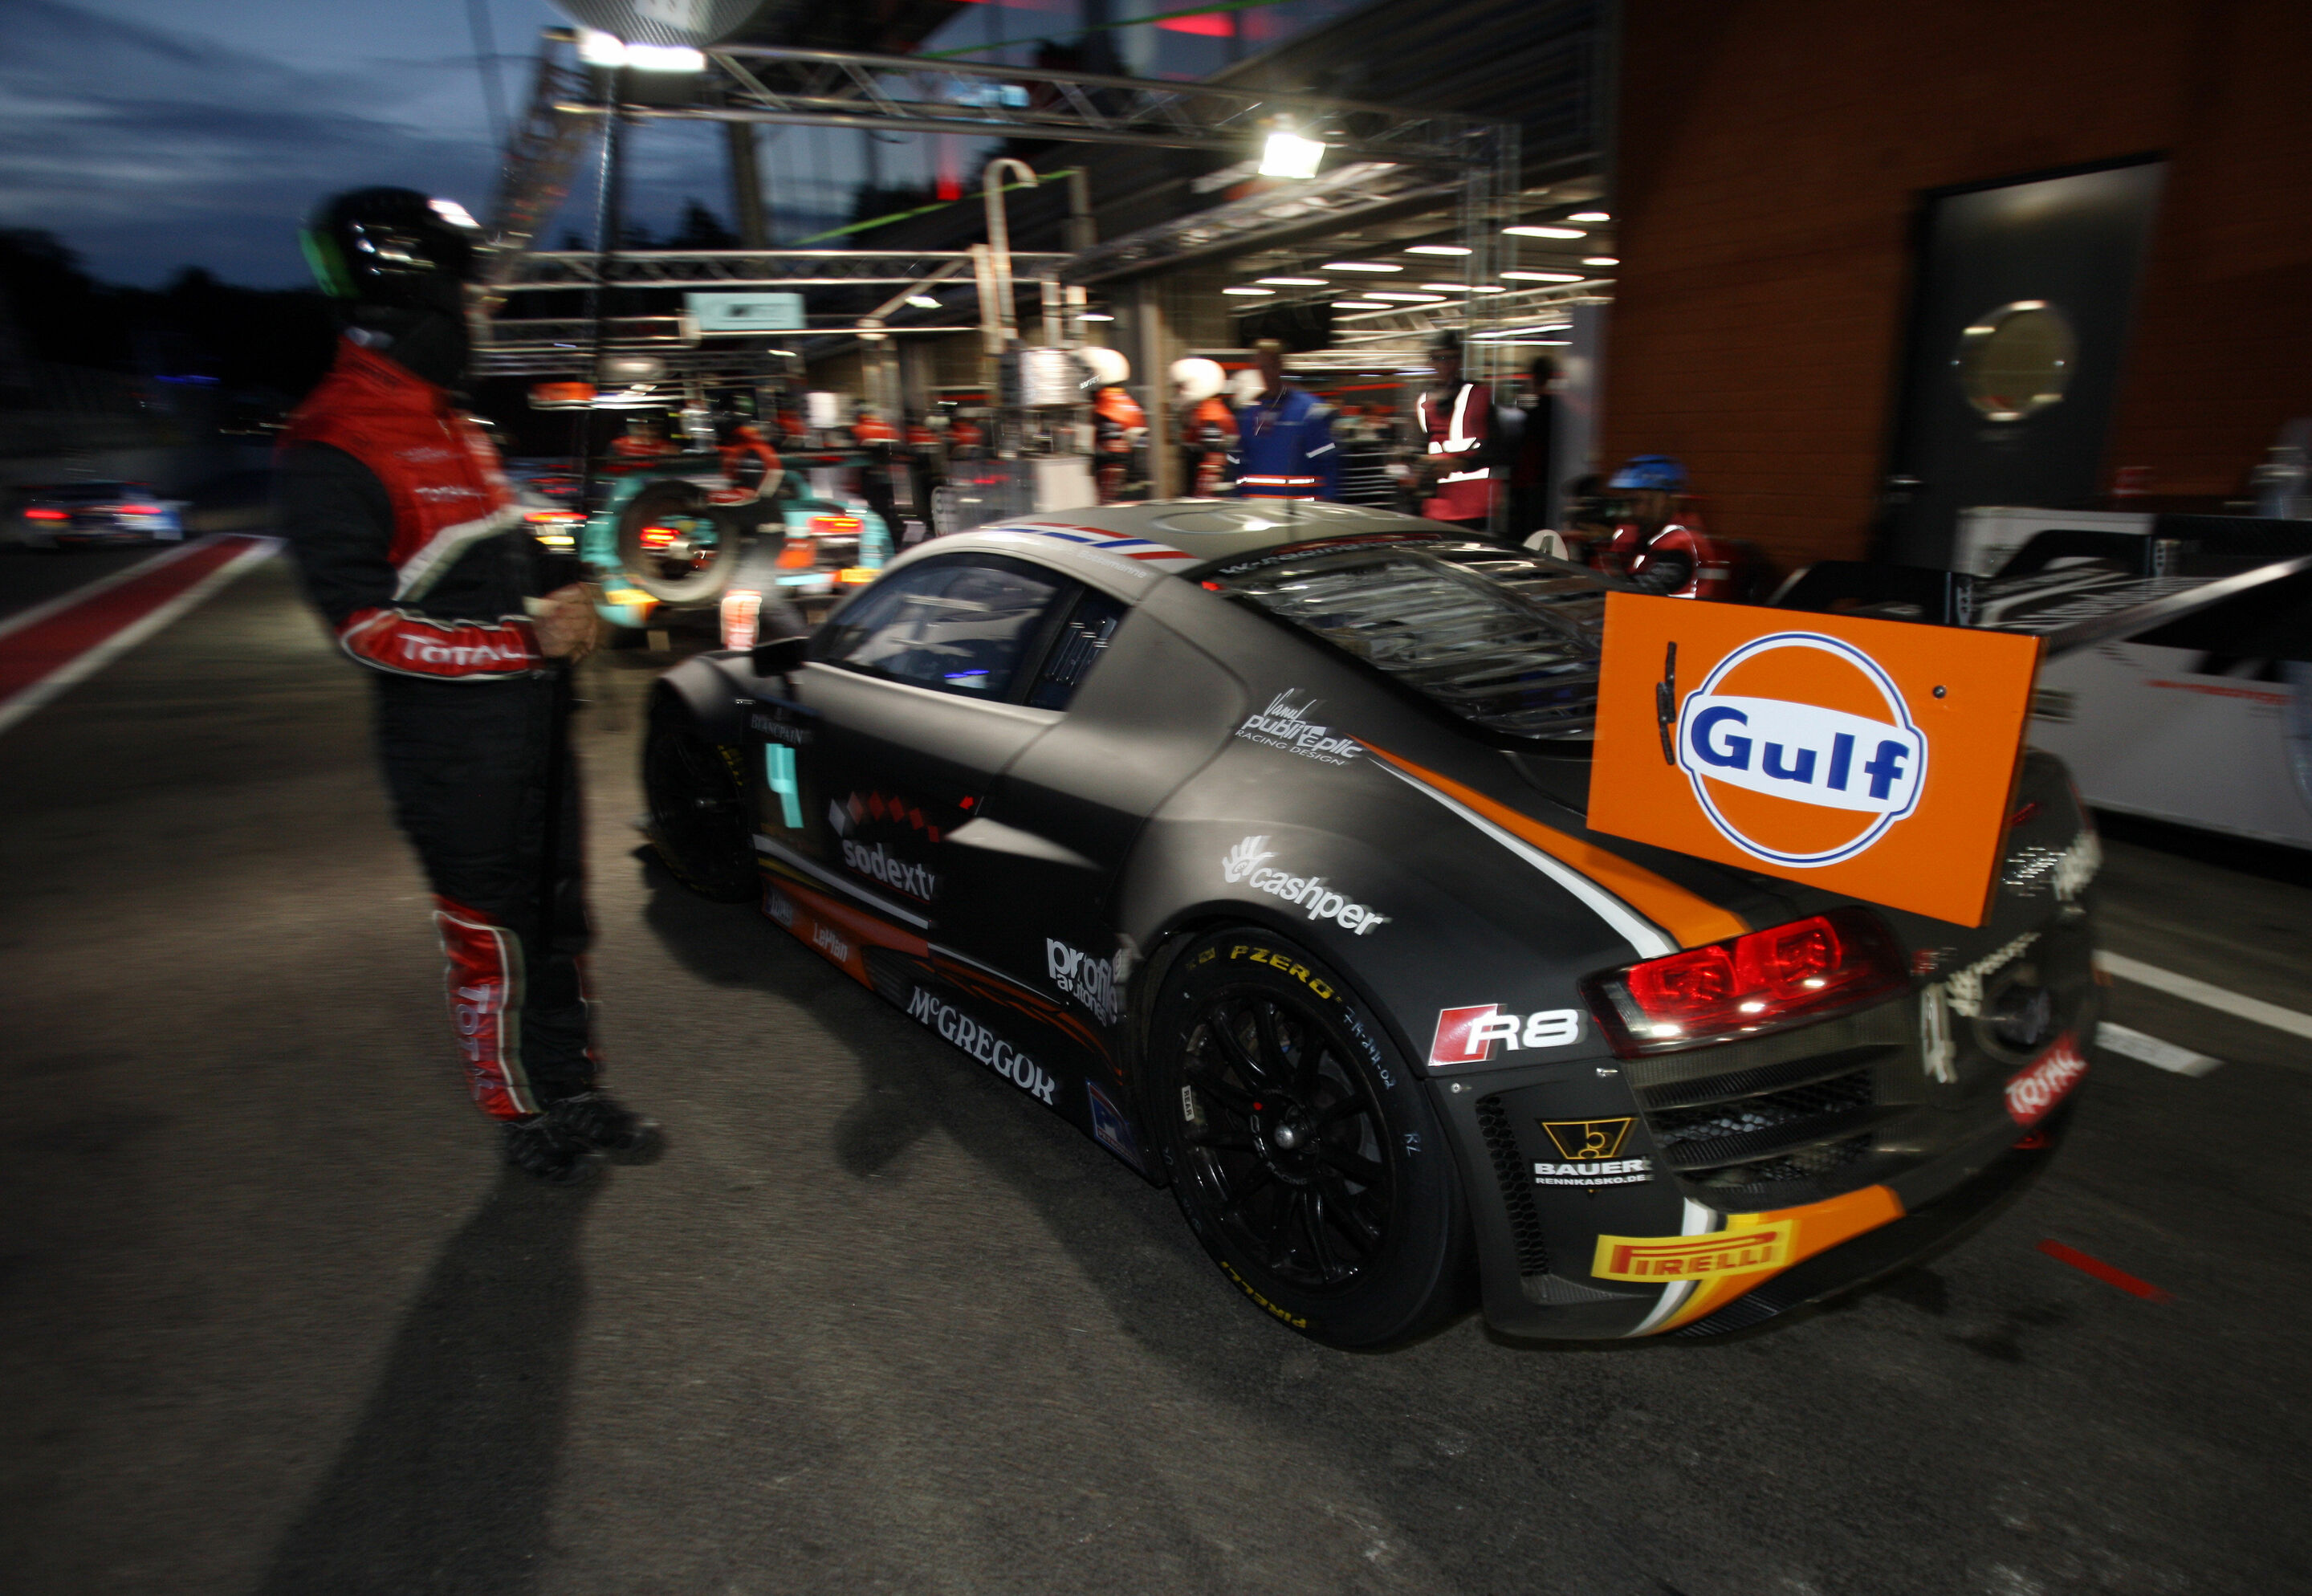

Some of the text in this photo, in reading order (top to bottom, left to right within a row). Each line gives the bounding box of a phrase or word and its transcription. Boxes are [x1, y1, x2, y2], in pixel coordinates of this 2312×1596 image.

[399, 633, 541, 666] TOTAL
[751, 713, 806, 746] BLANCPAIN
[1235, 729, 1345, 766] RACING DESIGN
[1690, 706, 1911, 801] Gulf
[1249, 867, 1384, 936] cashper
[1046, 937, 1118, 1025] profile
[1465, 1008, 1580, 1056] R8
[1183, 1090, 1193, 1118] REAR
[1533, 1158, 1646, 1177] BAUER
[1534, 1174, 1648, 1187] RENNKASKO.DE
[1609, 1232, 1777, 1276] PIRELLI
[1219, 1260, 1308, 1329] PIRELLI
